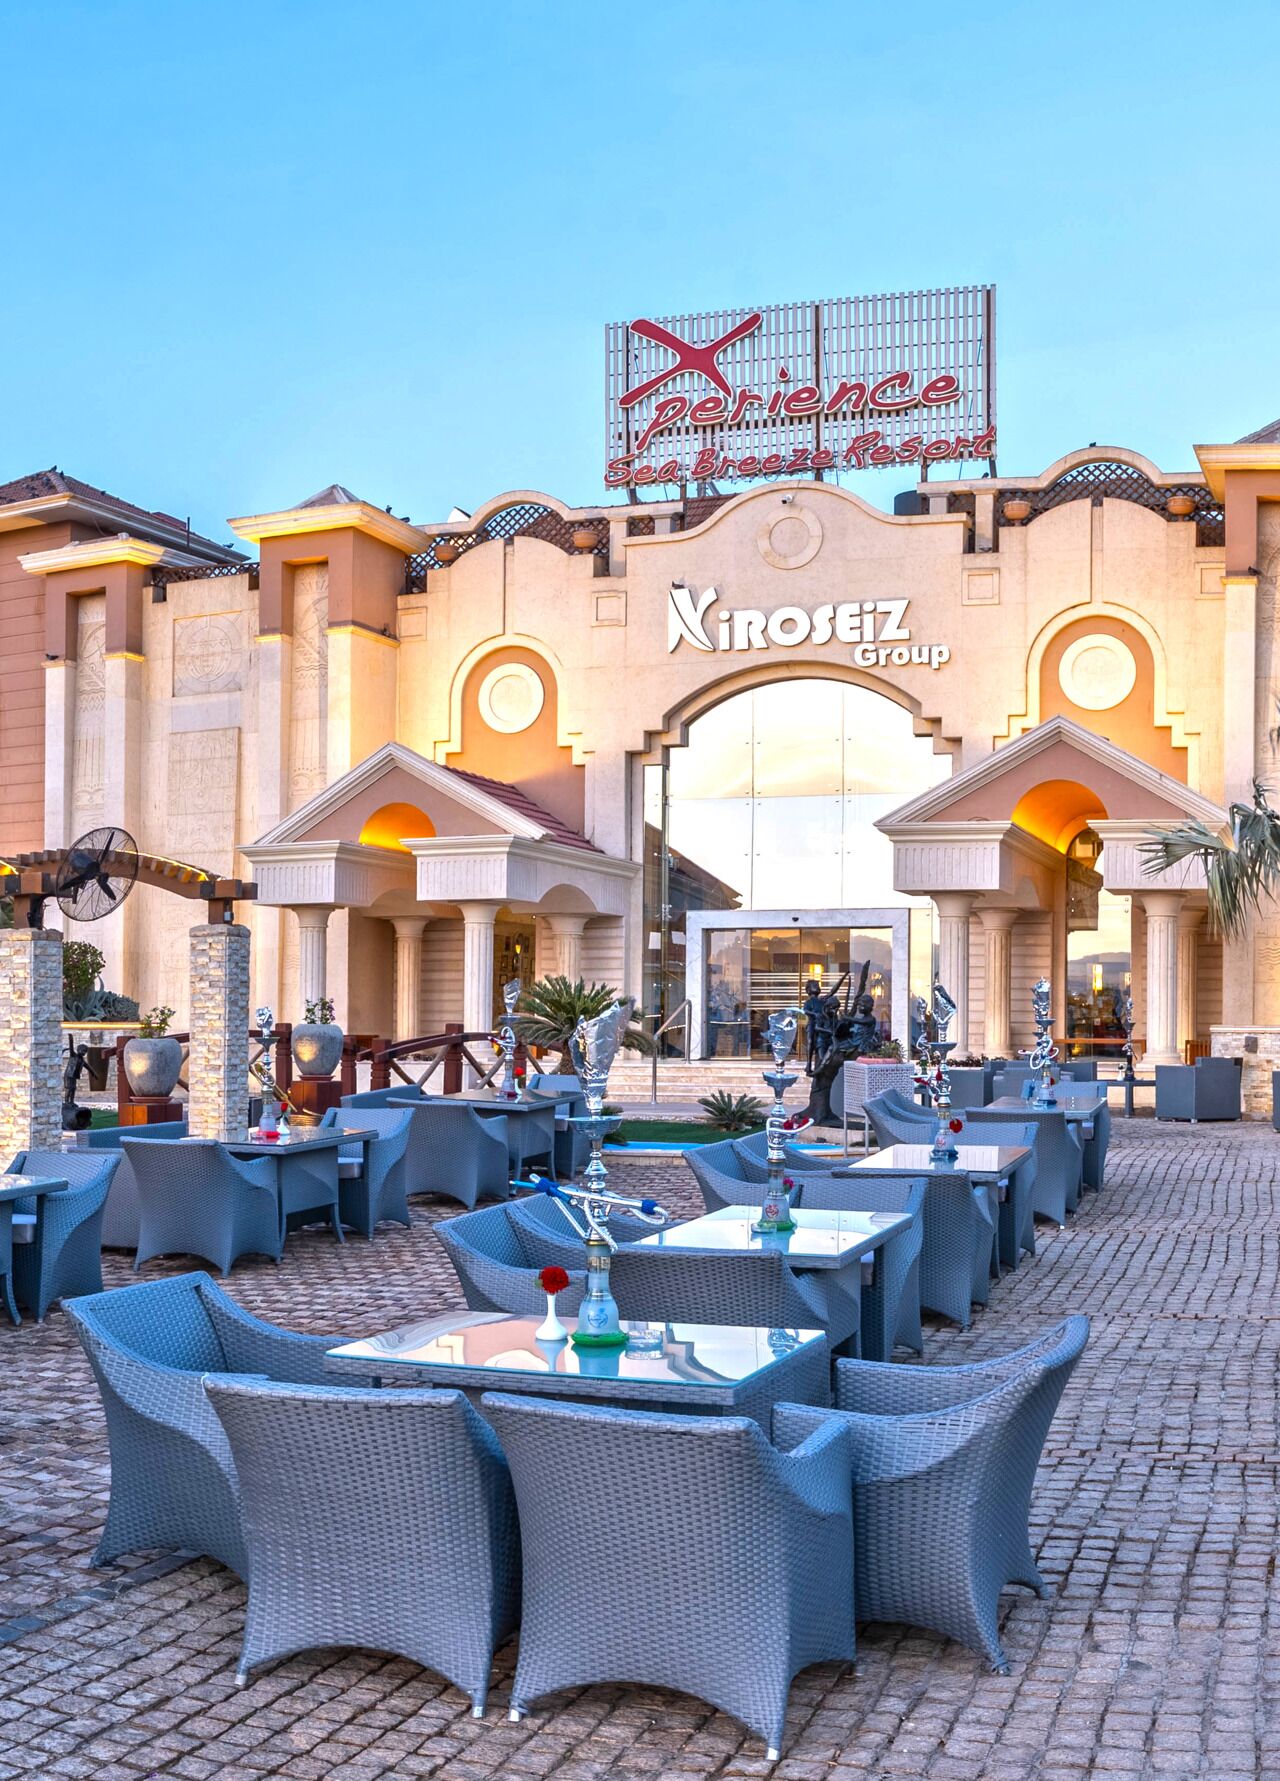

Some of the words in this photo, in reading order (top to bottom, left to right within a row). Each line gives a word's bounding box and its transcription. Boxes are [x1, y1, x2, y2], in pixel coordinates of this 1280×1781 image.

[604, 453, 678, 486] Sea
[691, 447, 834, 479] Breeze
[844, 425, 998, 470] Resort
[853, 643, 951, 670] Group
